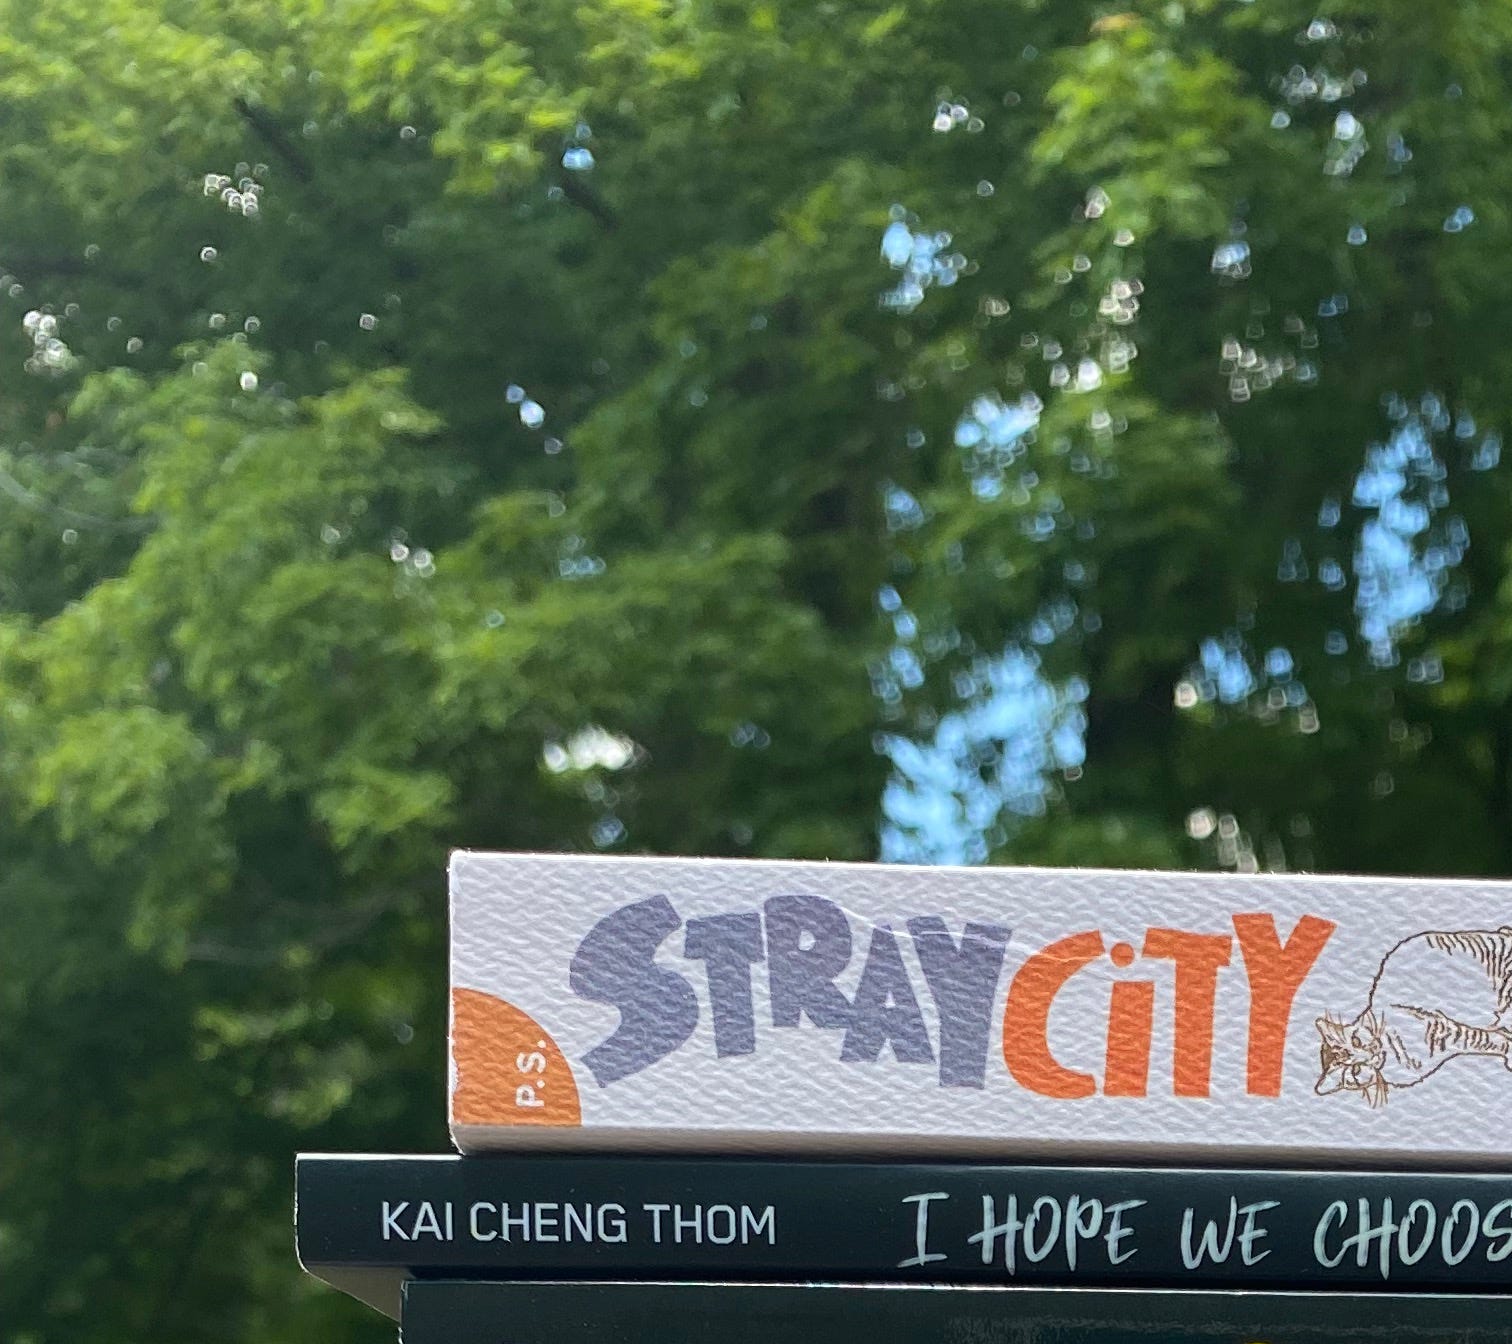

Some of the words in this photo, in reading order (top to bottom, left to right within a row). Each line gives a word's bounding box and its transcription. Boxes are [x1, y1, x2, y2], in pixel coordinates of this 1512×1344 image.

[569, 894, 1012, 1089] STRAY
[515, 1040, 547, 1107] P.S.
[381, 1200, 454, 1241] KAI
[470, 1202, 627, 1244] CHENG
[643, 1204, 777, 1246] THOM
[896, 1190, 950, 1270] I
[968, 1194, 1147, 1276] HOPE
[1181, 1196, 1281, 1270] WE
